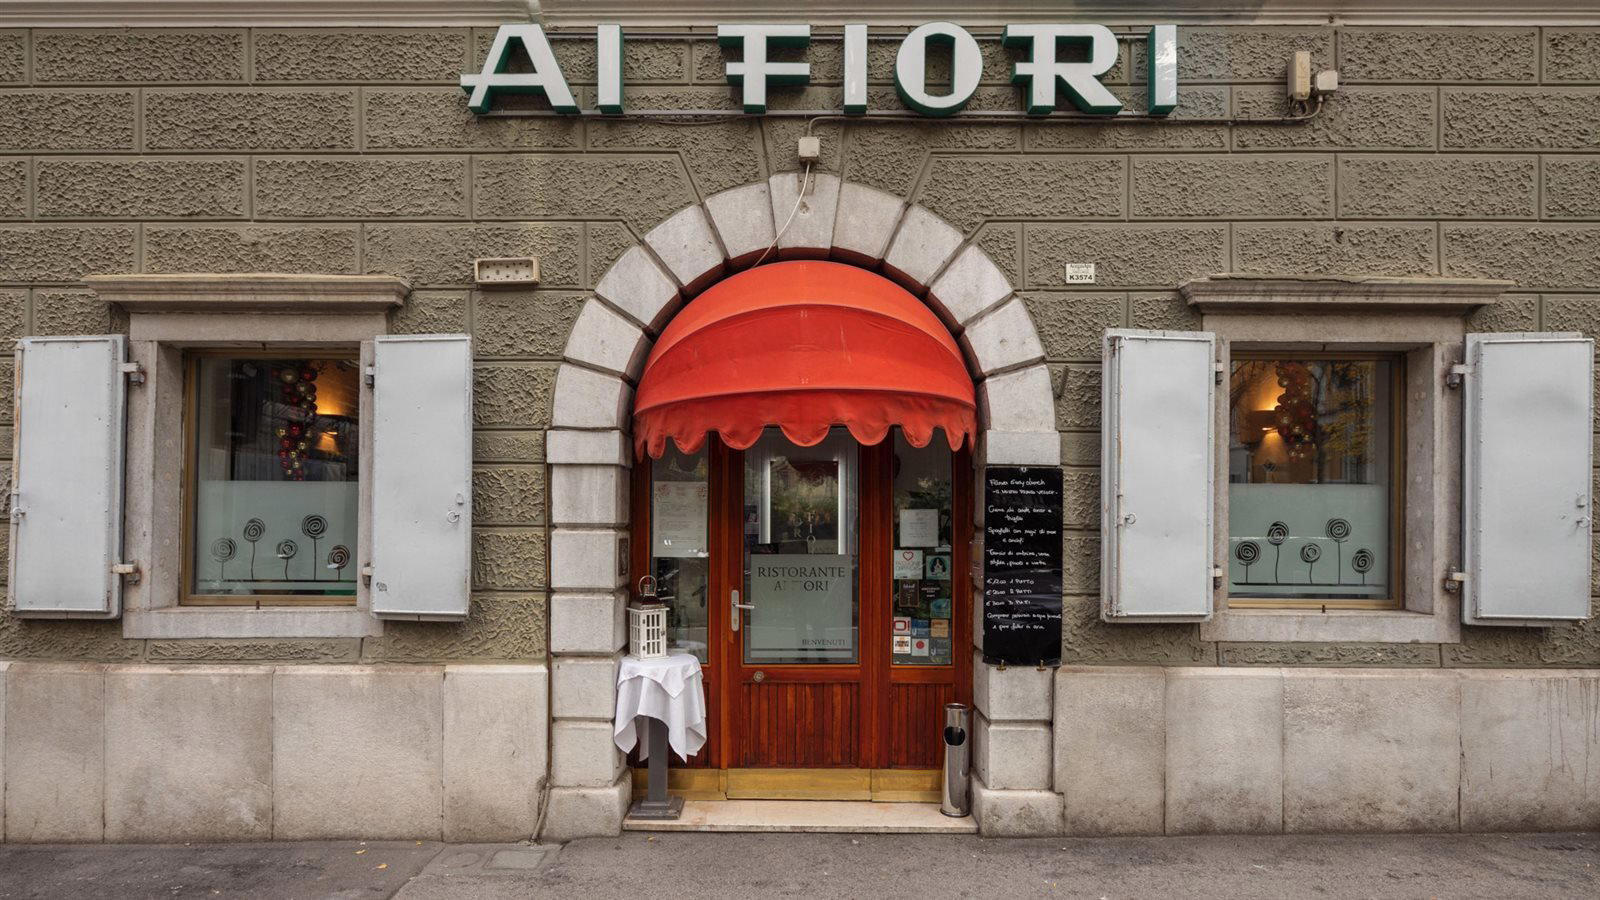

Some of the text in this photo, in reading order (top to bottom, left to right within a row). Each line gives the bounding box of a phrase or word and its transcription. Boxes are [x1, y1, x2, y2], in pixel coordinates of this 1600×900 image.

[460, 21, 1178, 117] AI FIORI
[757, 566, 846, 578] RISTORANTE
[801, 638, 847, 647] BENVENUTI
